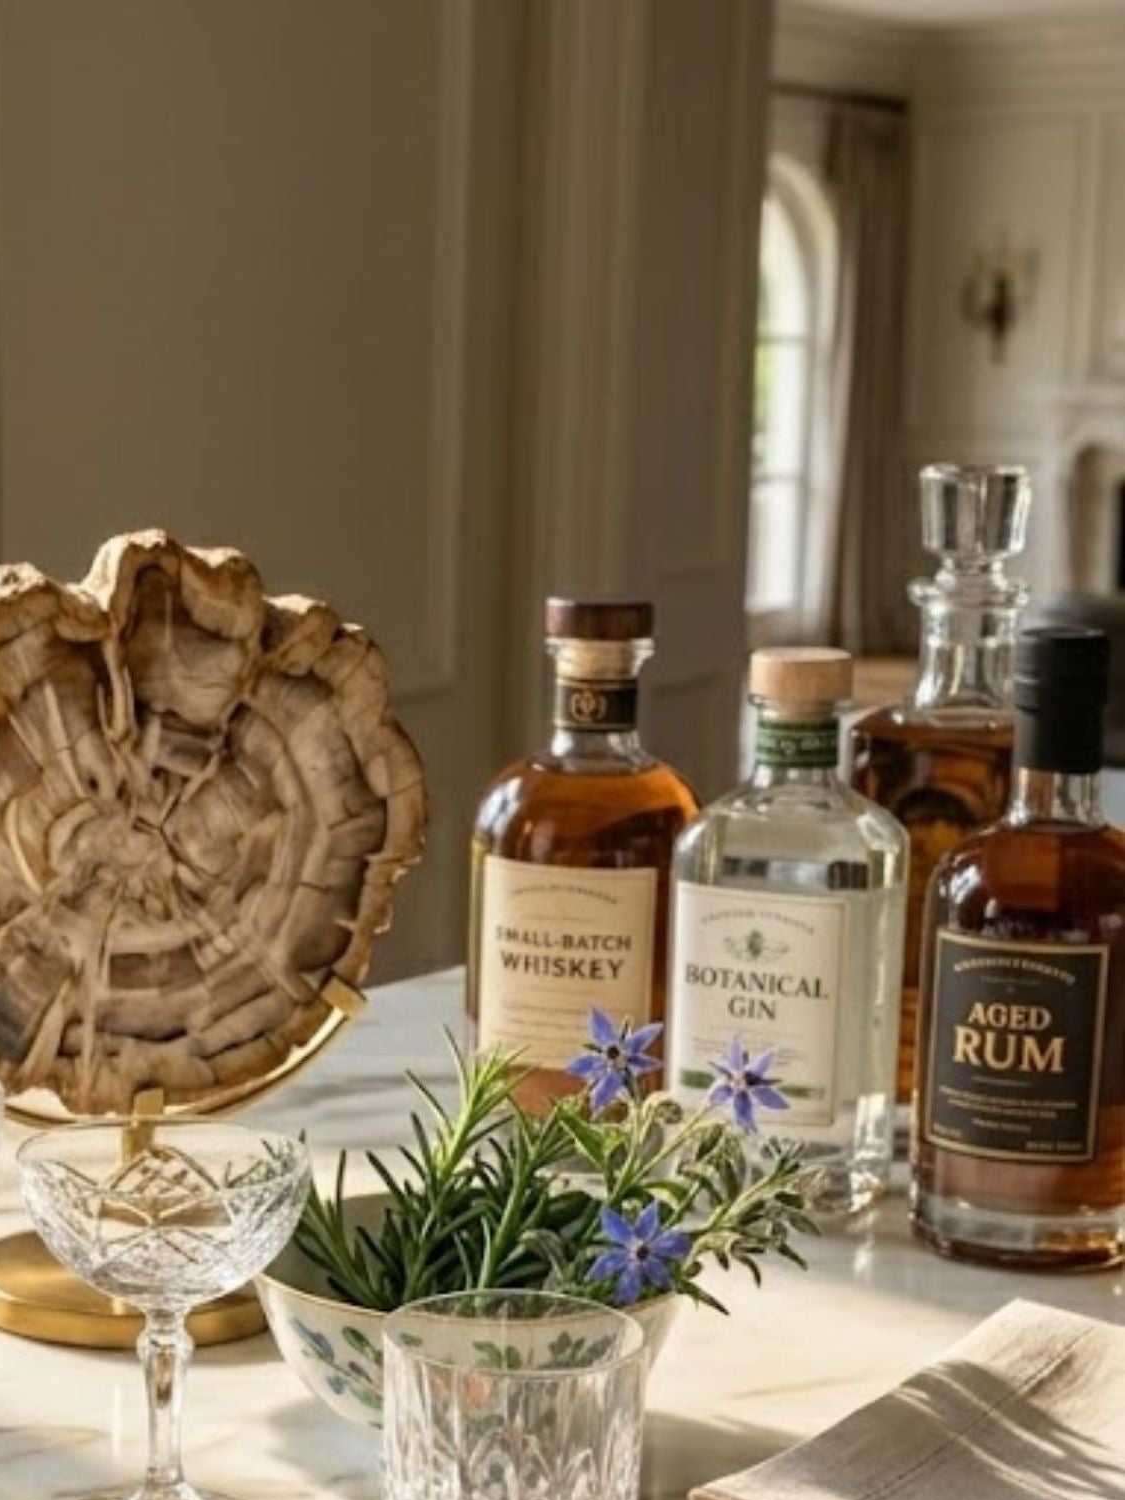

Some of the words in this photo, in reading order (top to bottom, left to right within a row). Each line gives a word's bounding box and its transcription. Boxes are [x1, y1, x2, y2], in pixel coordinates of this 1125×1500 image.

[501, 950, 624, 980] WHISKEY
[685, 963, 828, 999] BOTANICAL
[728, 995, 776, 1021] GIN
[968, 1001, 1051, 1030] AGED
[952, 1024, 1065, 1073] RUM
